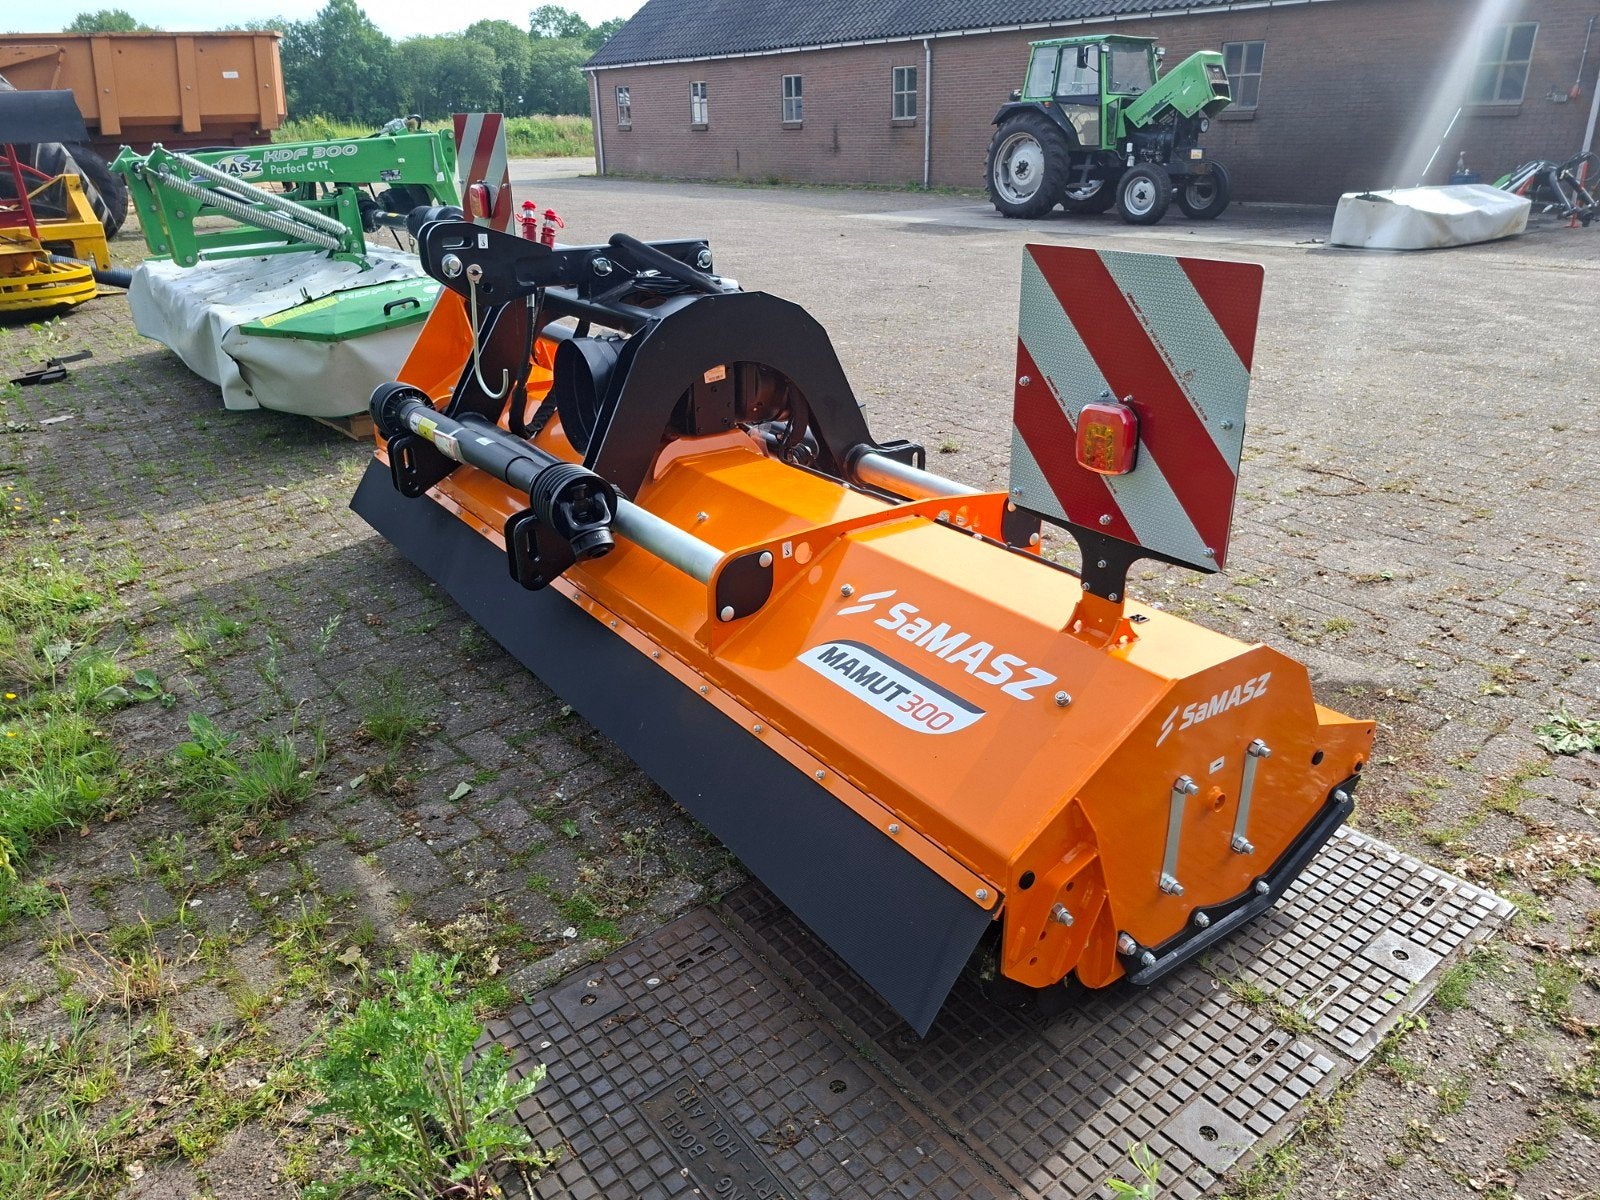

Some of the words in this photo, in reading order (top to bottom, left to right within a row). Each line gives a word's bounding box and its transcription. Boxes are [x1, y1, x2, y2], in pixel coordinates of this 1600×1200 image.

[263, 148, 308, 163] KDF
[312, 144, 358, 159] 300
[270, 163, 305, 174] Perfect
[874, 602, 1058, 700] SaMASZ
[1178, 671, 1272, 731] SaMASZ
